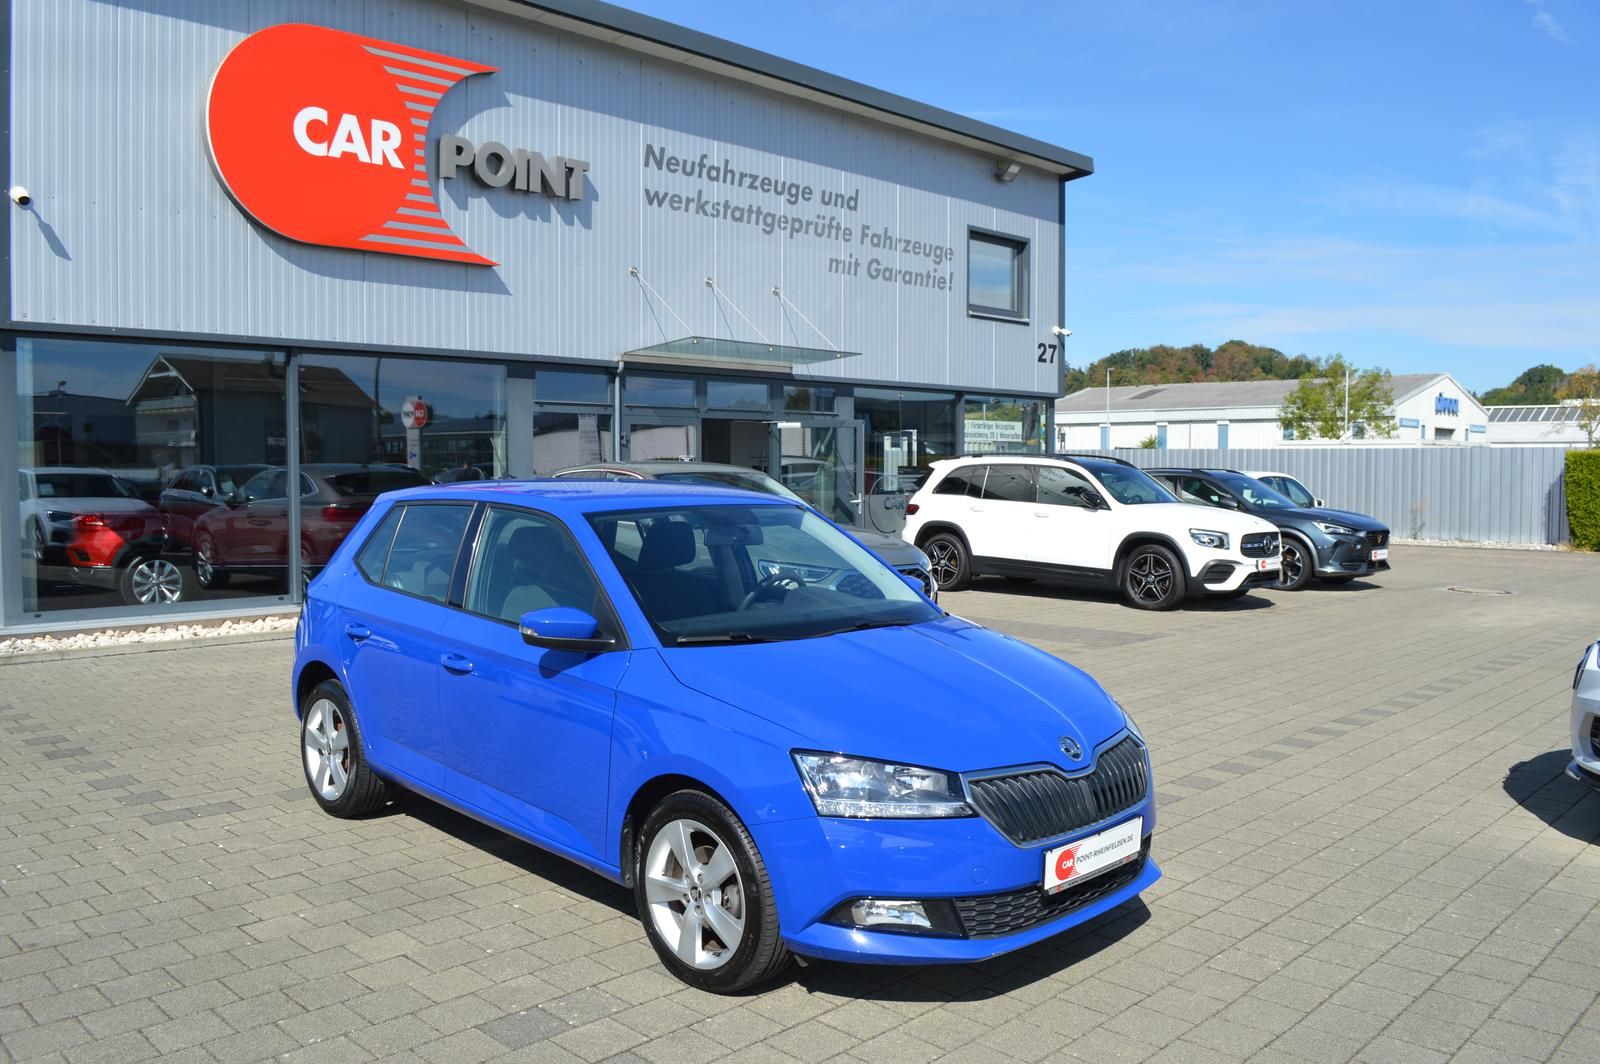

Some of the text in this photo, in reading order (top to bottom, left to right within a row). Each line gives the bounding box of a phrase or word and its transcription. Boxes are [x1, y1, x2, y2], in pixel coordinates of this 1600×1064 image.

[293, 107, 590, 201] CAR POINT
[644, 143, 859, 212] Neufahrzeuge und
[644, 188, 954, 263] werkstattgeprüfte Fahrzeuge
[829, 255, 954, 292] mit Garantie!
[1038, 343, 1057, 363] 27
[1062, 858, 1073, 869] CAR
